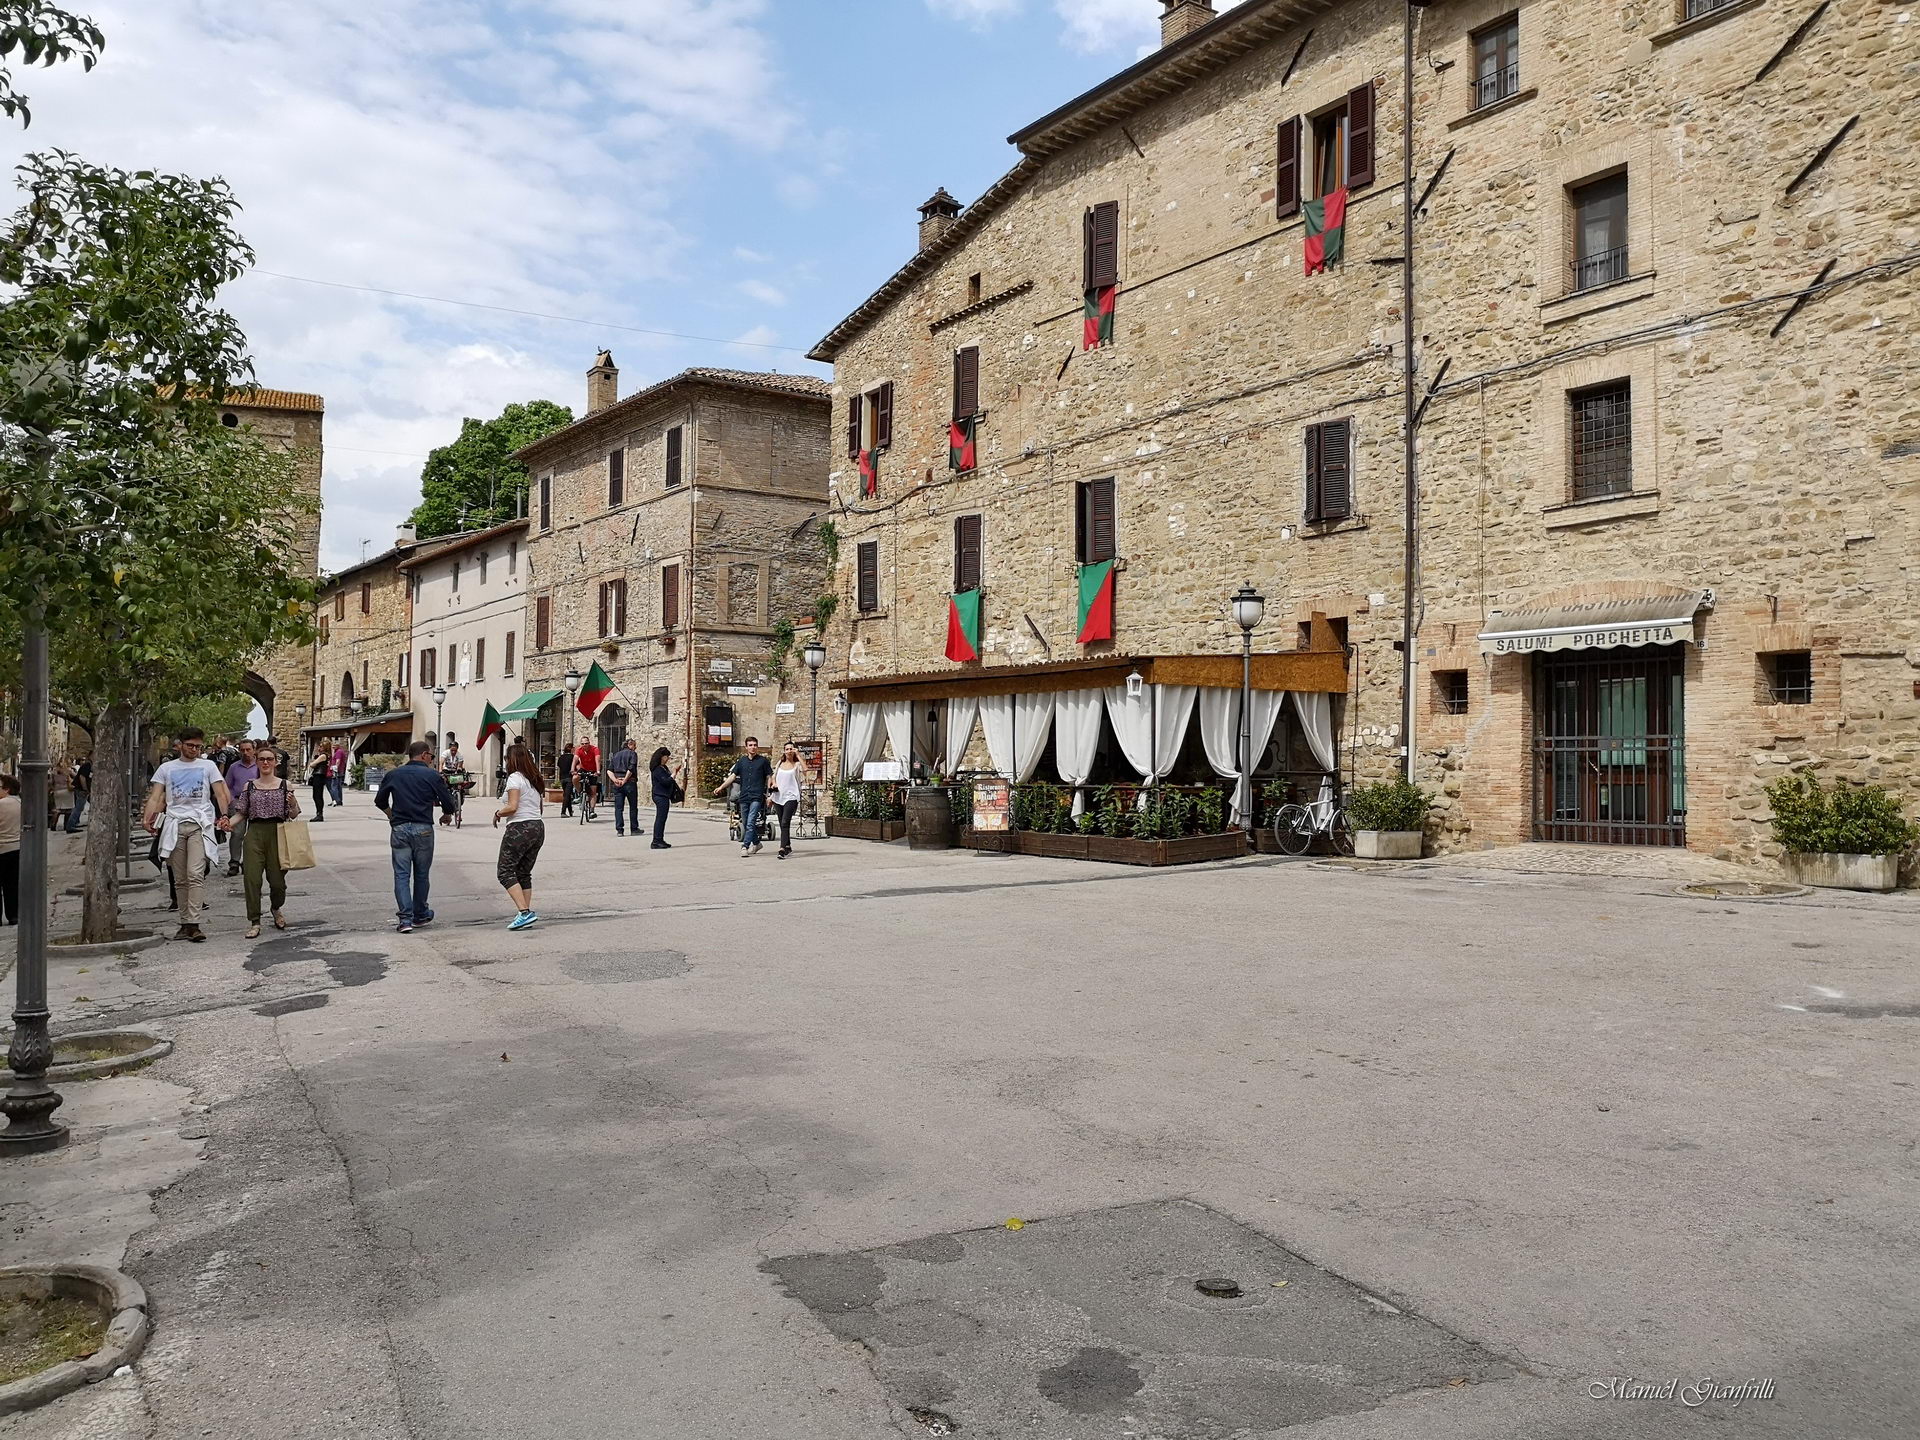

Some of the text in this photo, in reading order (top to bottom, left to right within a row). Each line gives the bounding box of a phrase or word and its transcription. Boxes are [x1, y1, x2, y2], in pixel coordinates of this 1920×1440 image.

[1496, 627, 1674, 651] SALUMI PORCHETTA
[1696, 640, 1705, 648] 16
